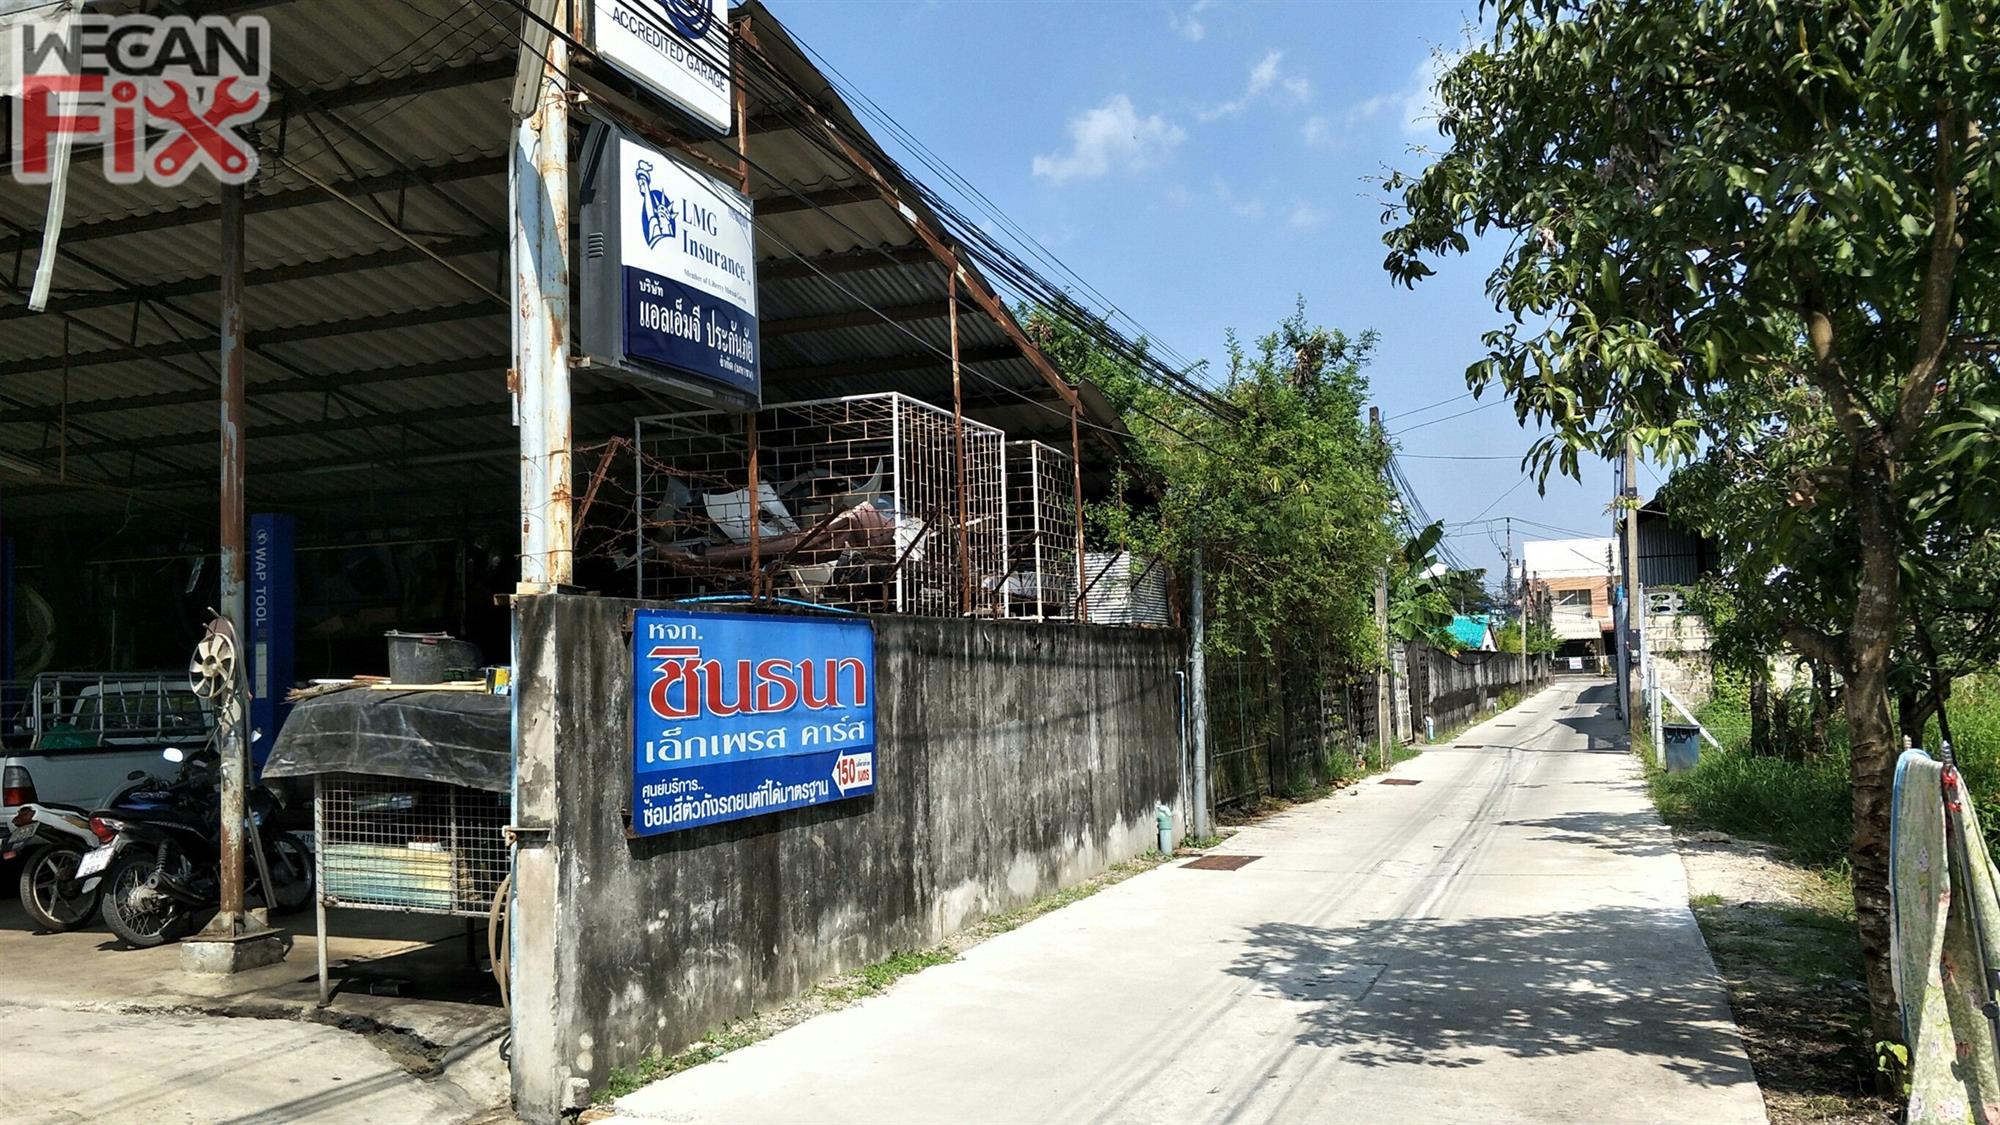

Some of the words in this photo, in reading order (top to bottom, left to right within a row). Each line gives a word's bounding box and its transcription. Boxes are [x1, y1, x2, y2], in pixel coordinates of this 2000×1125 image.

[612, 7, 684, 63] ACCREDITED
[686, 54, 725, 92] GARAGE
[682, 198, 718, 236] LMG
[683, 229, 746, 281] Insurance
[639, 278, 664, 297] บริษัท
[640, 298, 701, 343] แอลเอ็มจี
[706, 309, 753, 364] ประกันภัย
[255, 548, 267, 581] WAP
[255, 586, 267, 627] TOOL
[648, 623, 703, 640] หจก.
[647, 646, 867, 719] ชินธนา
[645, 726, 787, 764] เอ็กเพรส
[801, 715, 865, 746] คาร์ส
[836, 757, 856, 786] 150
